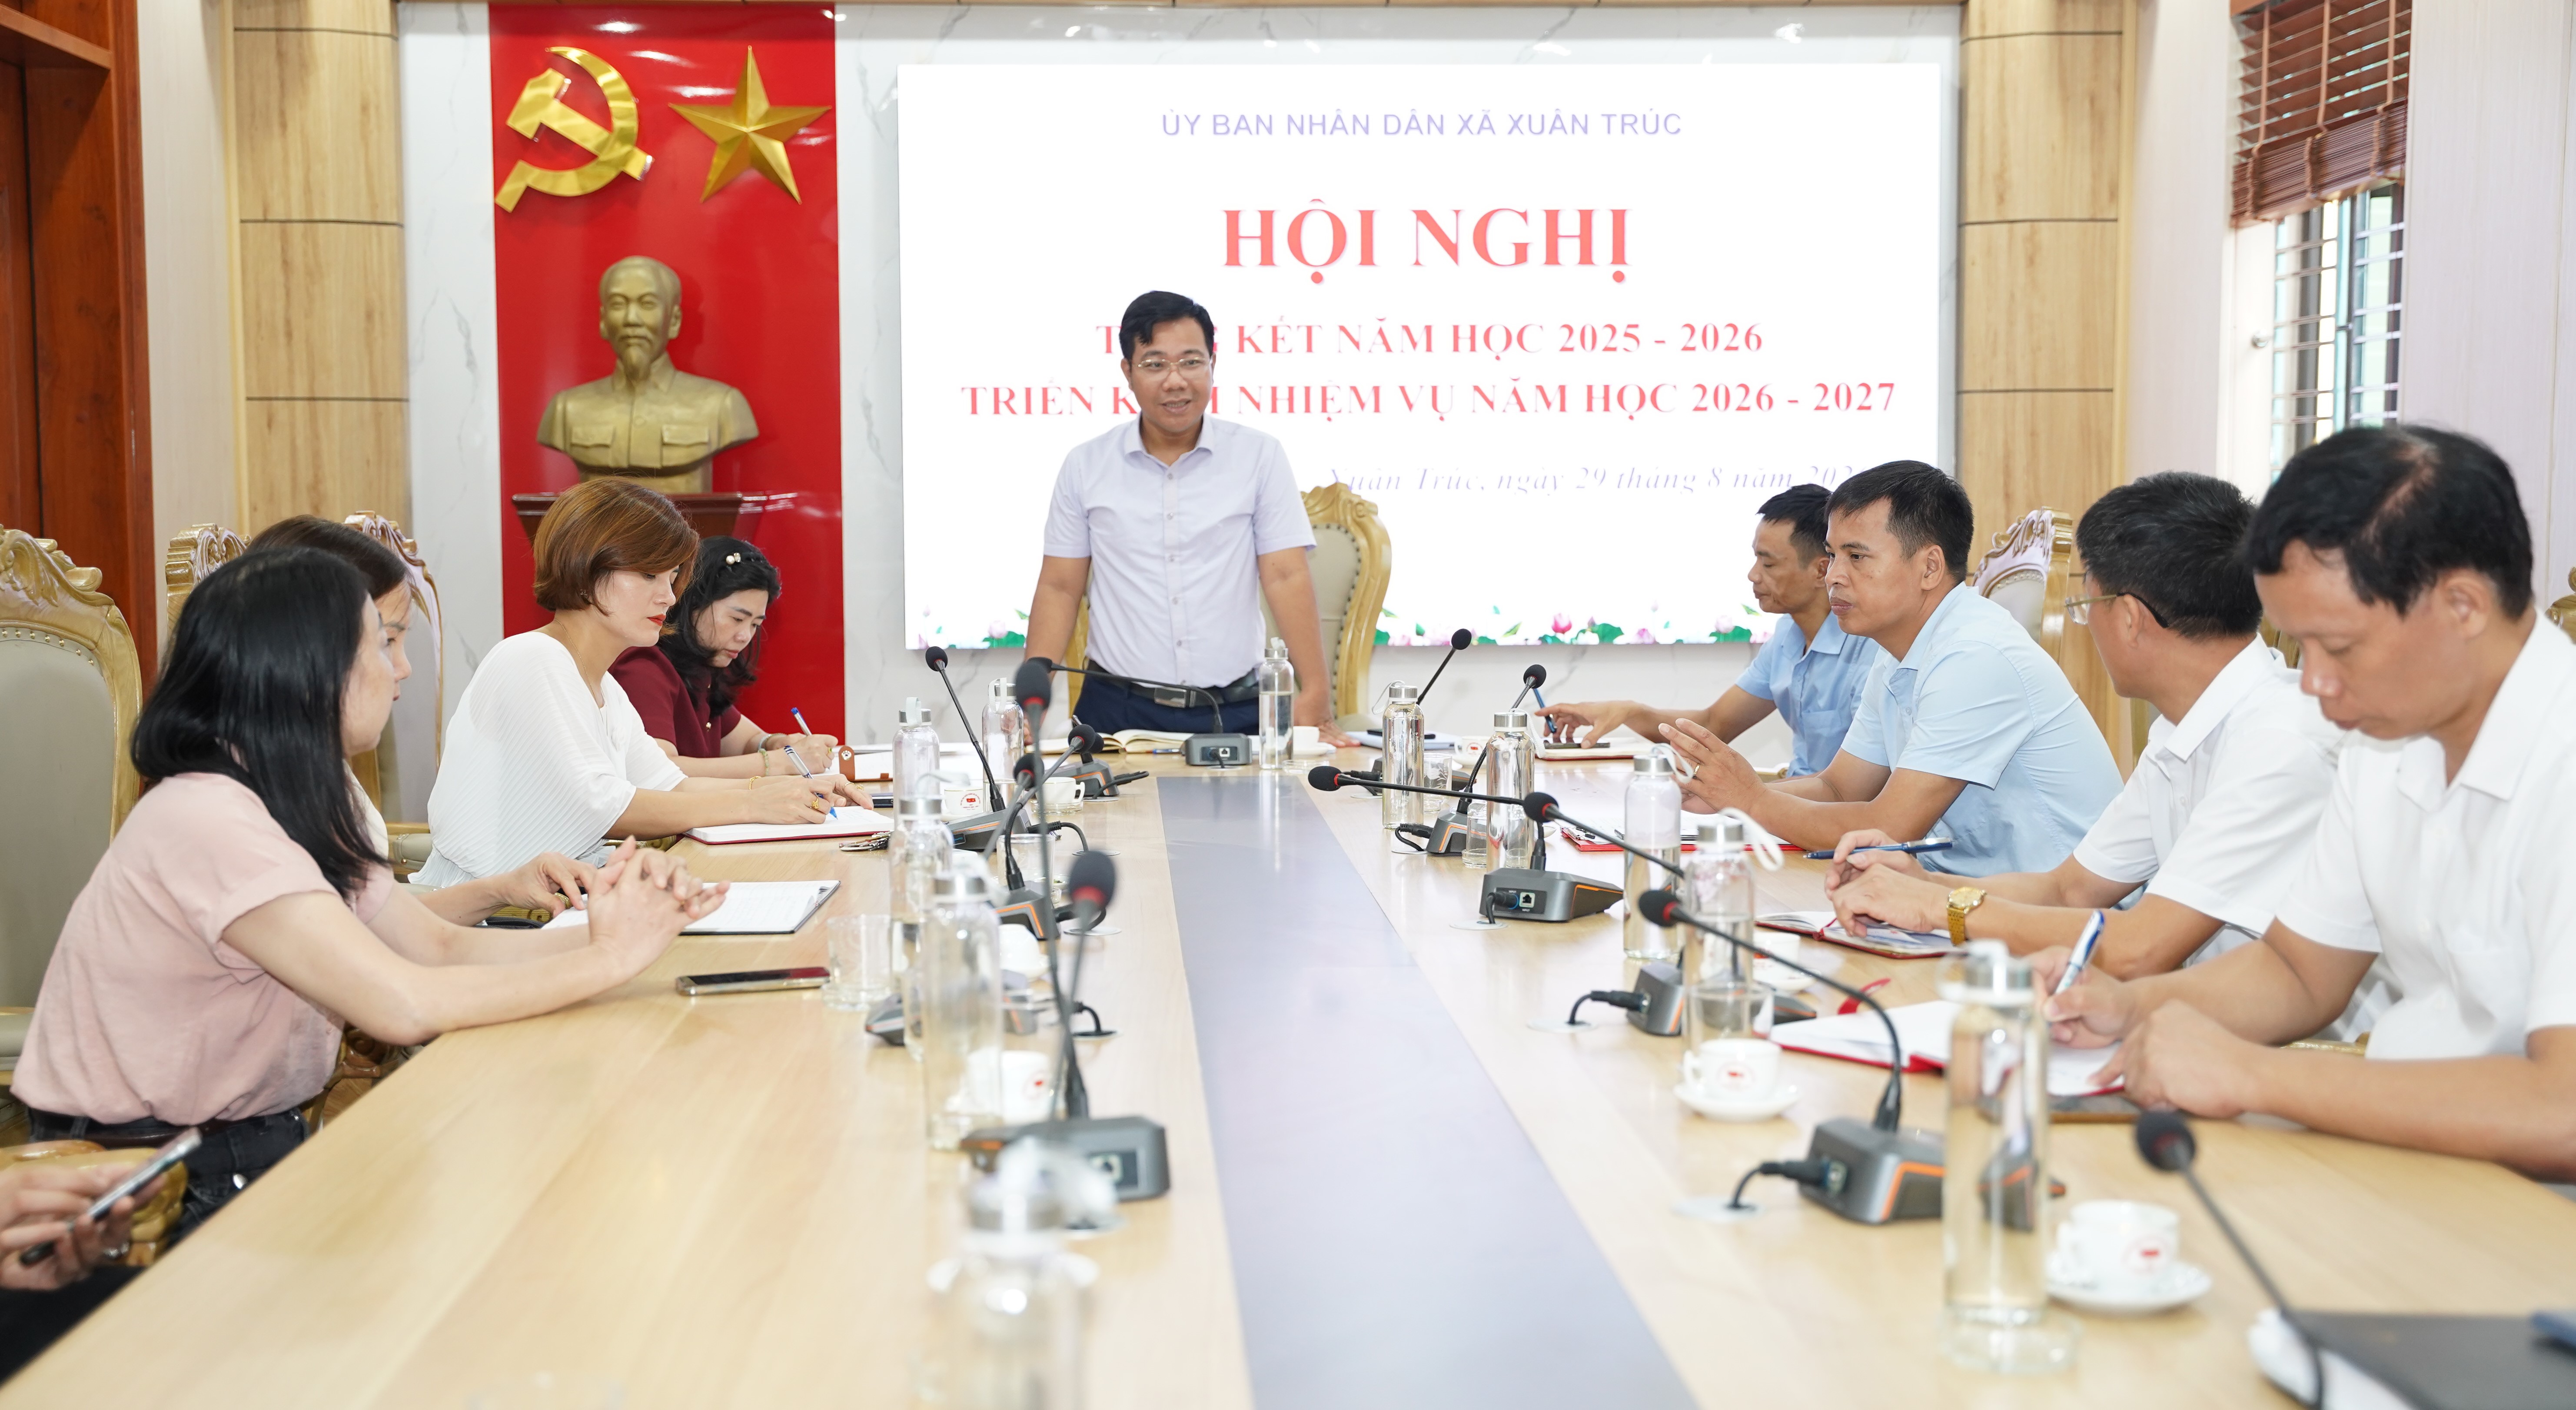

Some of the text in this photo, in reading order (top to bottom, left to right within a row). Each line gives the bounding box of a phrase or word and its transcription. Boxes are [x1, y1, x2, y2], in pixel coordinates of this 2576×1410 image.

[1213, 114, 1273, 136] BAN
[1287, 108, 1369, 136] NHÂN
[1384, 108, 1444, 136] DÂN
[1457, 109, 1496, 136] XÃ
[1507, 108, 1588, 136] XUÂN
[1601, 108, 1681, 135] TRÚC
[1222, 198, 1632, 285] HỘI NGHỊ
[1237, 315, 1323, 353] KẾT
[1337, 317, 1433, 353] NĂM
[1452, 323, 1543, 362] HỌC
[1559, 323, 1641, 353] 2025
[1680, 323, 1763, 352] 2026
[1238, 380, 1382, 422] NHIỆM
[1398, 385, 1454, 422] VỤ
[1472, 376, 1567, 413] NĂM
[1585, 383, 1677, 421] HỌC
[1692, 382, 1774, 412] 2026
[1813, 382, 1895, 412] 2027
[1417, 468, 1485, 491] Trúc,
[1498, 467, 1564, 496] ngày
[1576, 467, 1606, 489] 29
[1617, 466, 1695, 493] tháng
[1708, 467, 1722, 487] 8
[1733, 468, 1792, 488] năm
